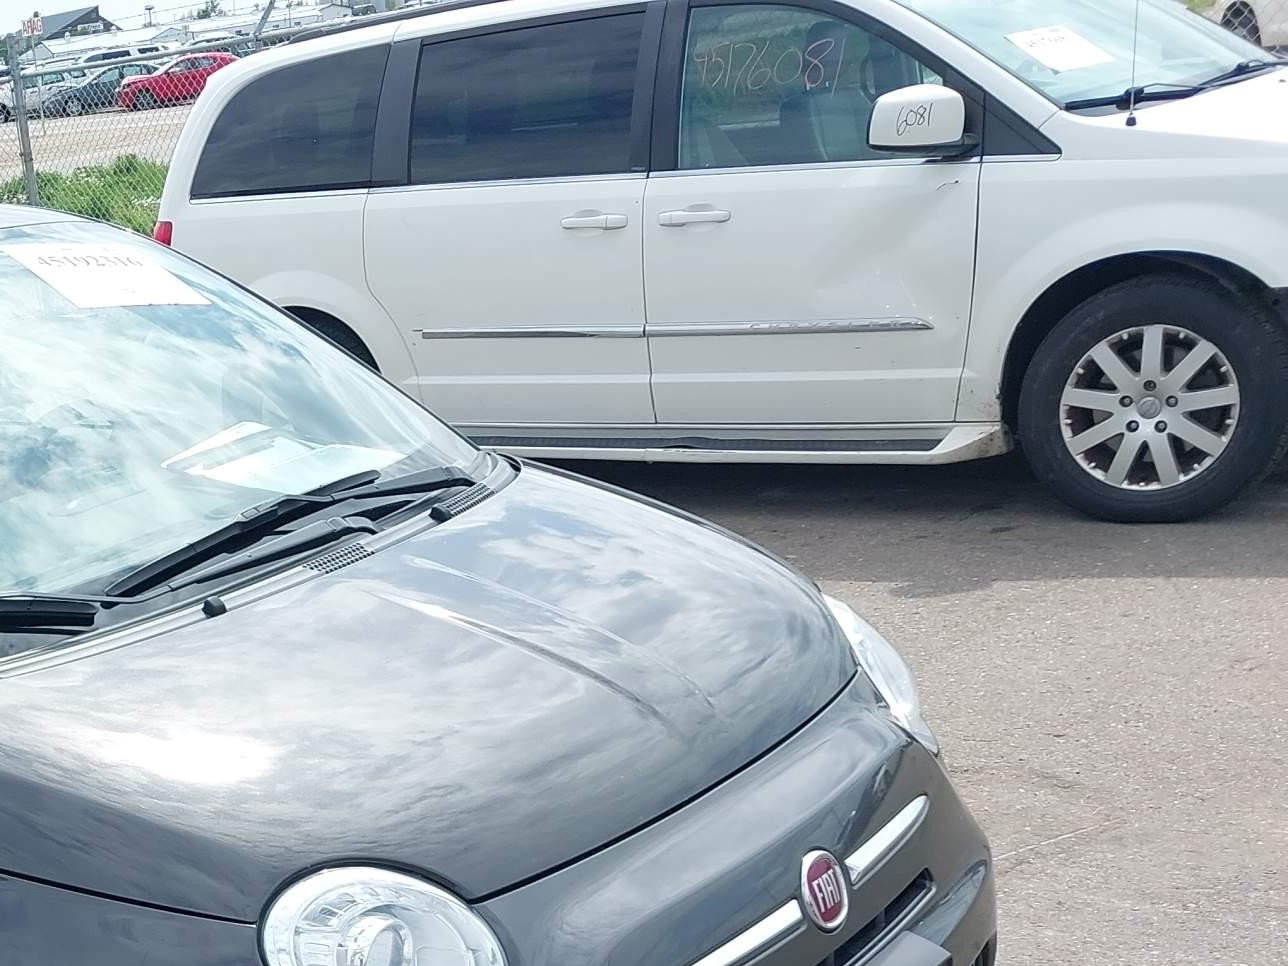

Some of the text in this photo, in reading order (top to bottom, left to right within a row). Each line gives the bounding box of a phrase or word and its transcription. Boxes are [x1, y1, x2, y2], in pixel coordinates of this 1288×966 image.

[693, 38, 847, 98] 45176081
[896, 102, 933, 137] 6081
[812, 868, 841, 913] FIAT
